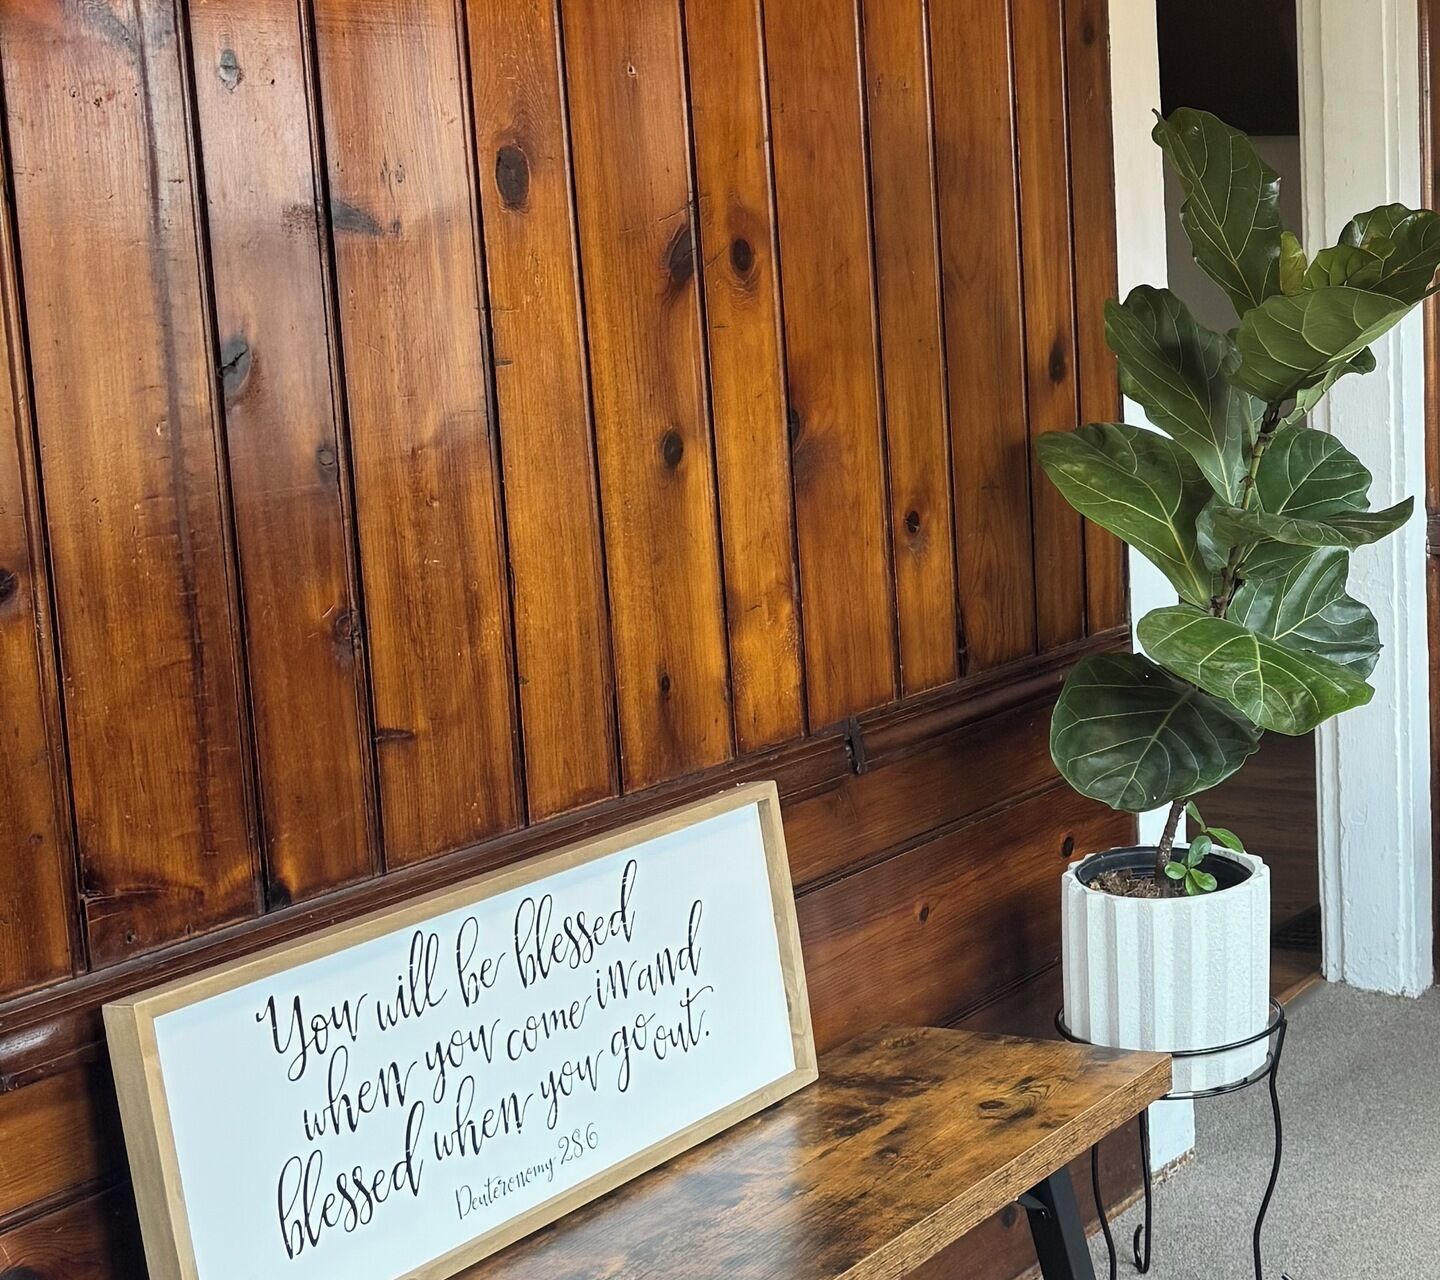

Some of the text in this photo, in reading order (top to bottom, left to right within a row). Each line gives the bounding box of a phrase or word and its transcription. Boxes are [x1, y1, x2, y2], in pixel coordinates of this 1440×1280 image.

[256, 859, 637, 1081] You will be blessed
[304, 900, 703, 1140] when you come in and
[276, 986, 714, 1259] blessed when you go out.
[455, 1156, 557, 1219] Deuteronomy
